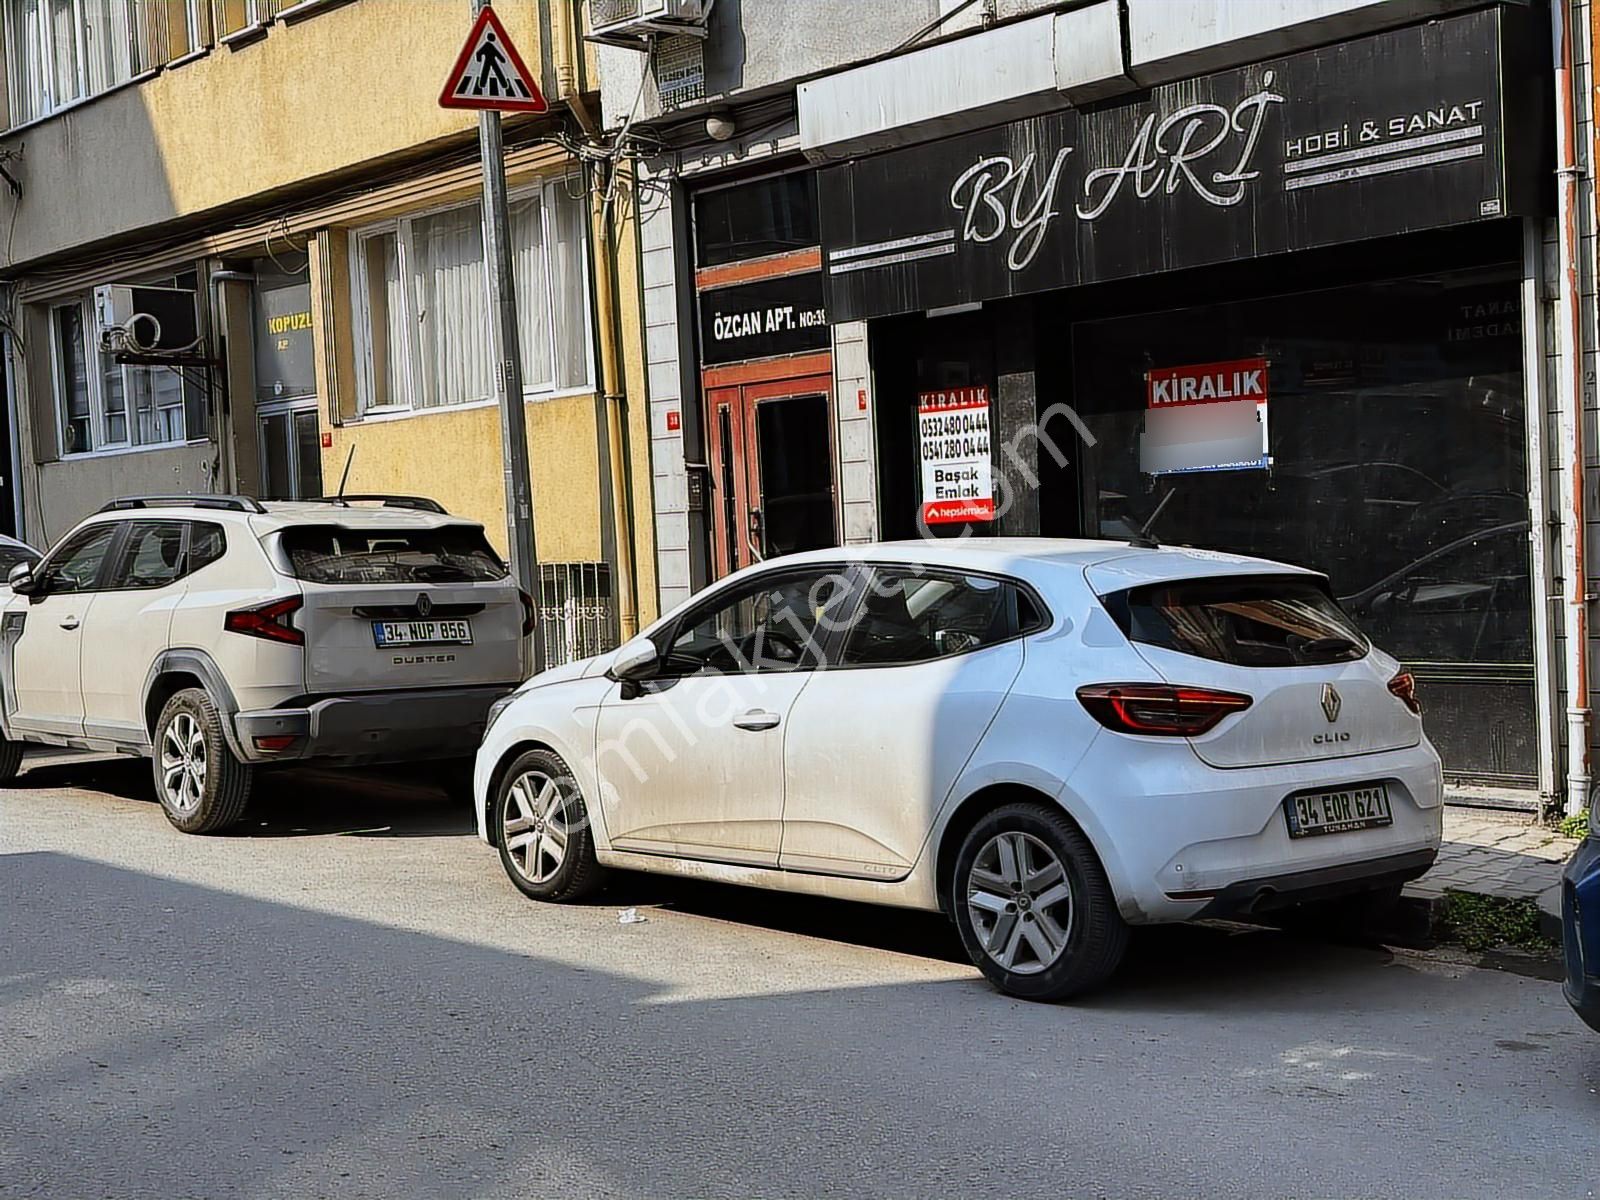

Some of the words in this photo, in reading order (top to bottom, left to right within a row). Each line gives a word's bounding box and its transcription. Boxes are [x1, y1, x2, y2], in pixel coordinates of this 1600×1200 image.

[1286, 124, 1348, 156] HOBİ
[1359, 121, 1380, 142] &
[1389, 101, 1483, 136] SANAT
[951, 147, 1073, 271] BY
[268, 312, 312, 334] KOPUZL
[714, 311, 761, 340] ÖZCAN
[765, 306, 795, 333] APT.
[1152, 371, 1263, 404] KİRALIK
[922, 417, 943, 438] 0532
[944, 415, 961, 436] 480
[922, 440, 943, 461] 0541
[945, 438, 961, 459] 280
[934, 467, 978, 483] Başak
[935, 484, 979, 499] Emlak
[384, 623, 403, 641] 34
[408, 622, 434, 641] NUP
[440, 622, 466, 639] 856
[393, 654, 456, 665] DUSTER
[1313, 732, 1351, 744] CLIO
[1297, 796, 1319, 826] 34
[1354, 789, 1383, 818] 621
